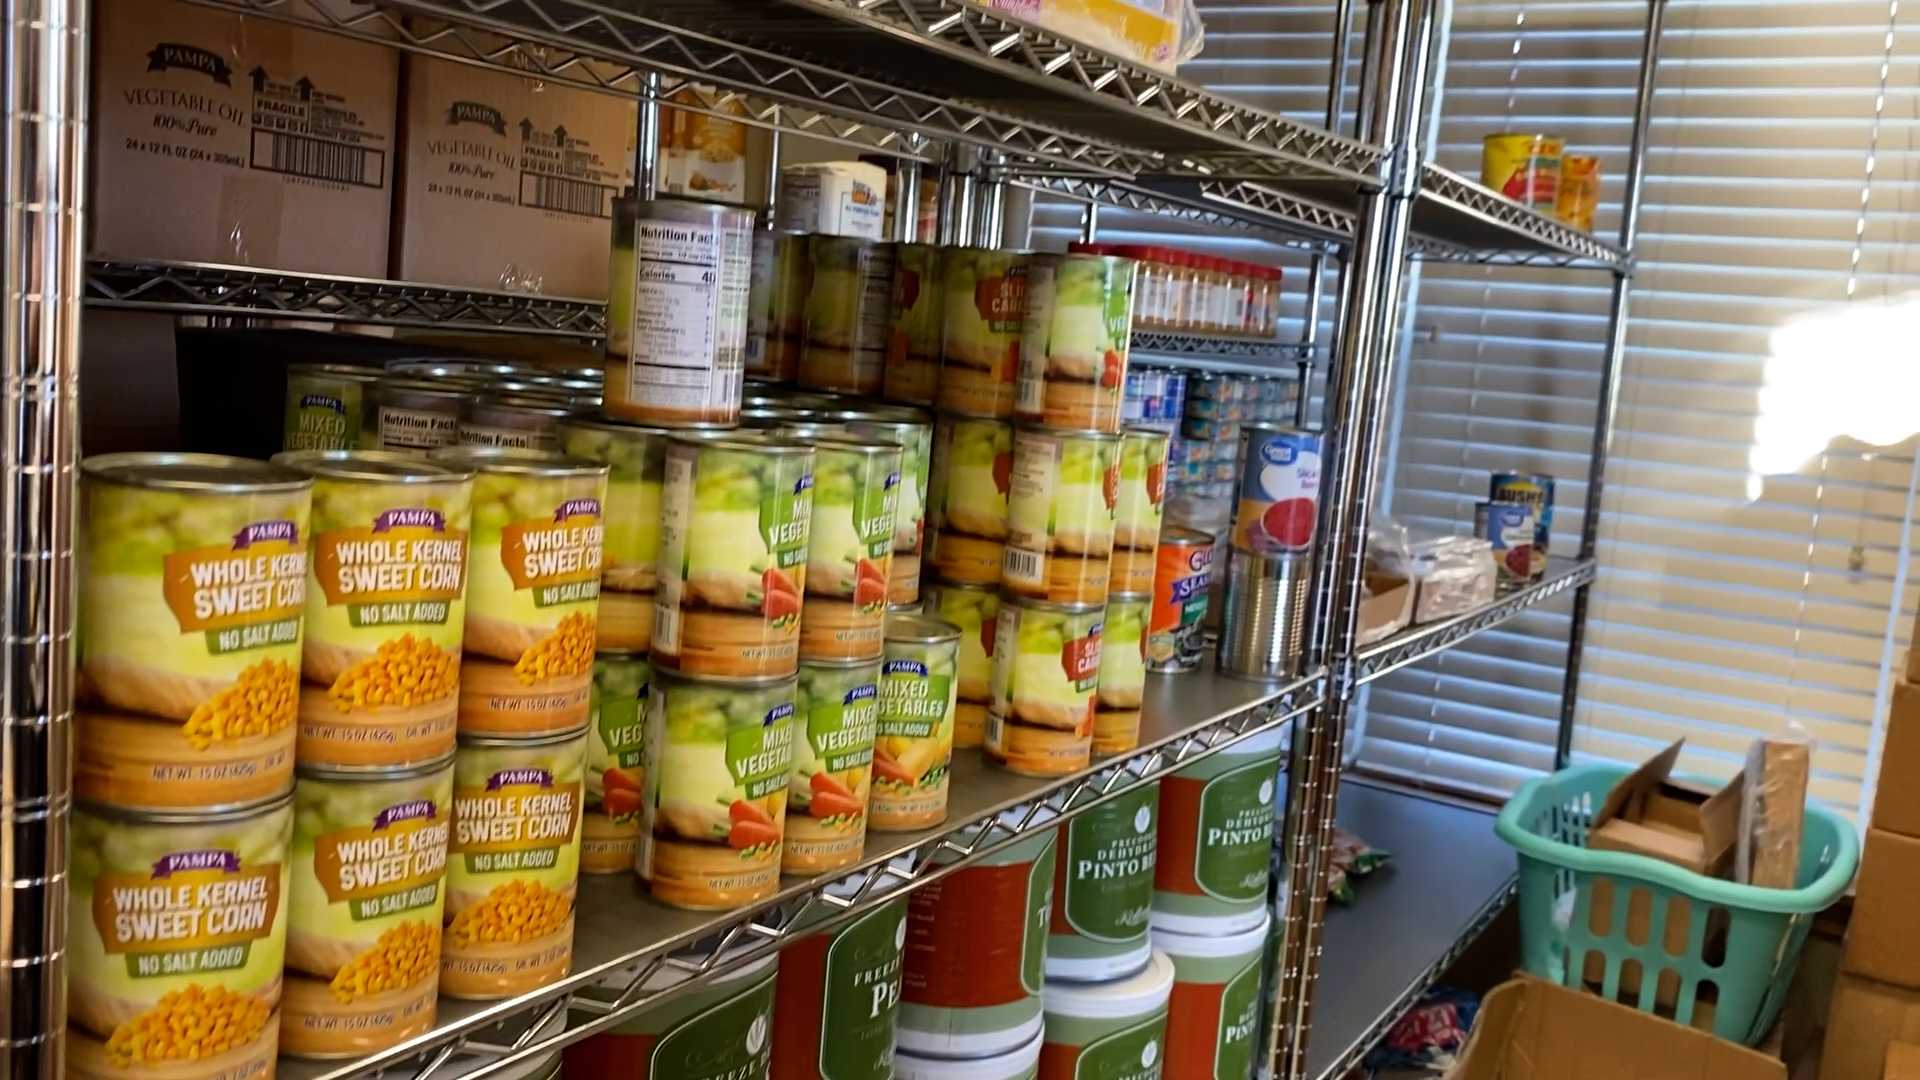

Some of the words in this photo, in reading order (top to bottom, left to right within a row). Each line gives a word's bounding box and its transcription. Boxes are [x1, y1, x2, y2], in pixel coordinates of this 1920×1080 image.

[164, 48, 216, 72] PAMPA
[124, 87, 214, 113] VEGETABLE
[218, 103, 247, 126] OIL
[257, 100, 305, 117] FRAGILE
[457, 105, 496, 123] PAMPA
[186, 118, 218, 136] Pure
[126, 137, 138, 150] 24
[149, 142, 160, 153] 12
[428, 140, 492, 161] VEGETABLE
[496, 150, 516, 170] OIL
[471, 164, 494, 179] Pure
[640, 226, 687, 242] Nutrition
[640, 269, 676, 281] Calories
[305, 396, 337, 408] PAMPA
[301, 414, 346, 434] MIXED
[384, 413, 428, 428] Nutrition
[495, 434, 526, 449] Facts
[387, 512, 436, 526] PAMPA
[248, 523, 292, 541] PAMPA
[522, 528, 581, 553] WHOLE
[336, 540, 408, 565] WHOLE
[411, 539, 462, 562] KERNEL
[190, 556, 268, 588] WHOLE
[524, 549, 584, 579] SWEET
[338, 563, 416, 594] SWEET
[418, 563, 461, 592] CORN
[193, 580, 275, 620] SWEET
[543, 588, 558, 605] NO
[560, 584, 580, 601] SALT
[360, 607, 379, 624] NO
[382, 605, 411, 623] SALT
[412, 602, 446, 622] ADDED
[219, 630, 240, 651] NO
[242, 625, 271, 648] SALT
[888, 659, 921, 674] PAMPA
[879, 679, 929, 700] MIXED
[842, 703, 876, 730] MIXE
[877, 700, 944, 718] GETABLES
[609, 725, 644, 748] VEG
[762, 724, 793, 751] MIXE
[885, 722, 903, 736] SALT
[904, 721, 930, 737] ADDED
[627, 754, 641, 767] NO
[832, 757, 845, 773] NO
[500, 771, 543, 785] PAMPA
[752, 783, 765, 799] NO
[386, 802, 429, 821] PAMPA
[456, 797, 516, 820] WHOLE
[520, 791, 573, 815] KERNEL
[456, 817, 528, 845] SWEET
[529, 814, 572, 839] CORN
[1207, 826, 1262, 847] PINTO
[337, 832, 404, 862] WHOLE
[168, 852, 226, 870] PAMPA
[339, 854, 414, 892] SWEET
[415, 848, 447, 877] CORN
[474, 855, 493, 872] NO
[494, 852, 520, 870] SALT
[520, 850, 554, 868] ADDED
[1077, 858, 1139, 880] PINTO
[113, 883, 191, 912] WHOLE
[197, 876, 268, 906] KERNEL
[360, 898, 380, 918] NO
[383, 893, 408, 914] SALT
[409, 886, 436, 908] ADDED
[115, 908, 203, 943] SWEET
[207, 901, 268, 935] CORN
[138, 955, 159, 976] NO
[163, 951, 197, 972] SALT
[200, 946, 244, 969] ADDED
[869, 980, 899, 1019] PE
